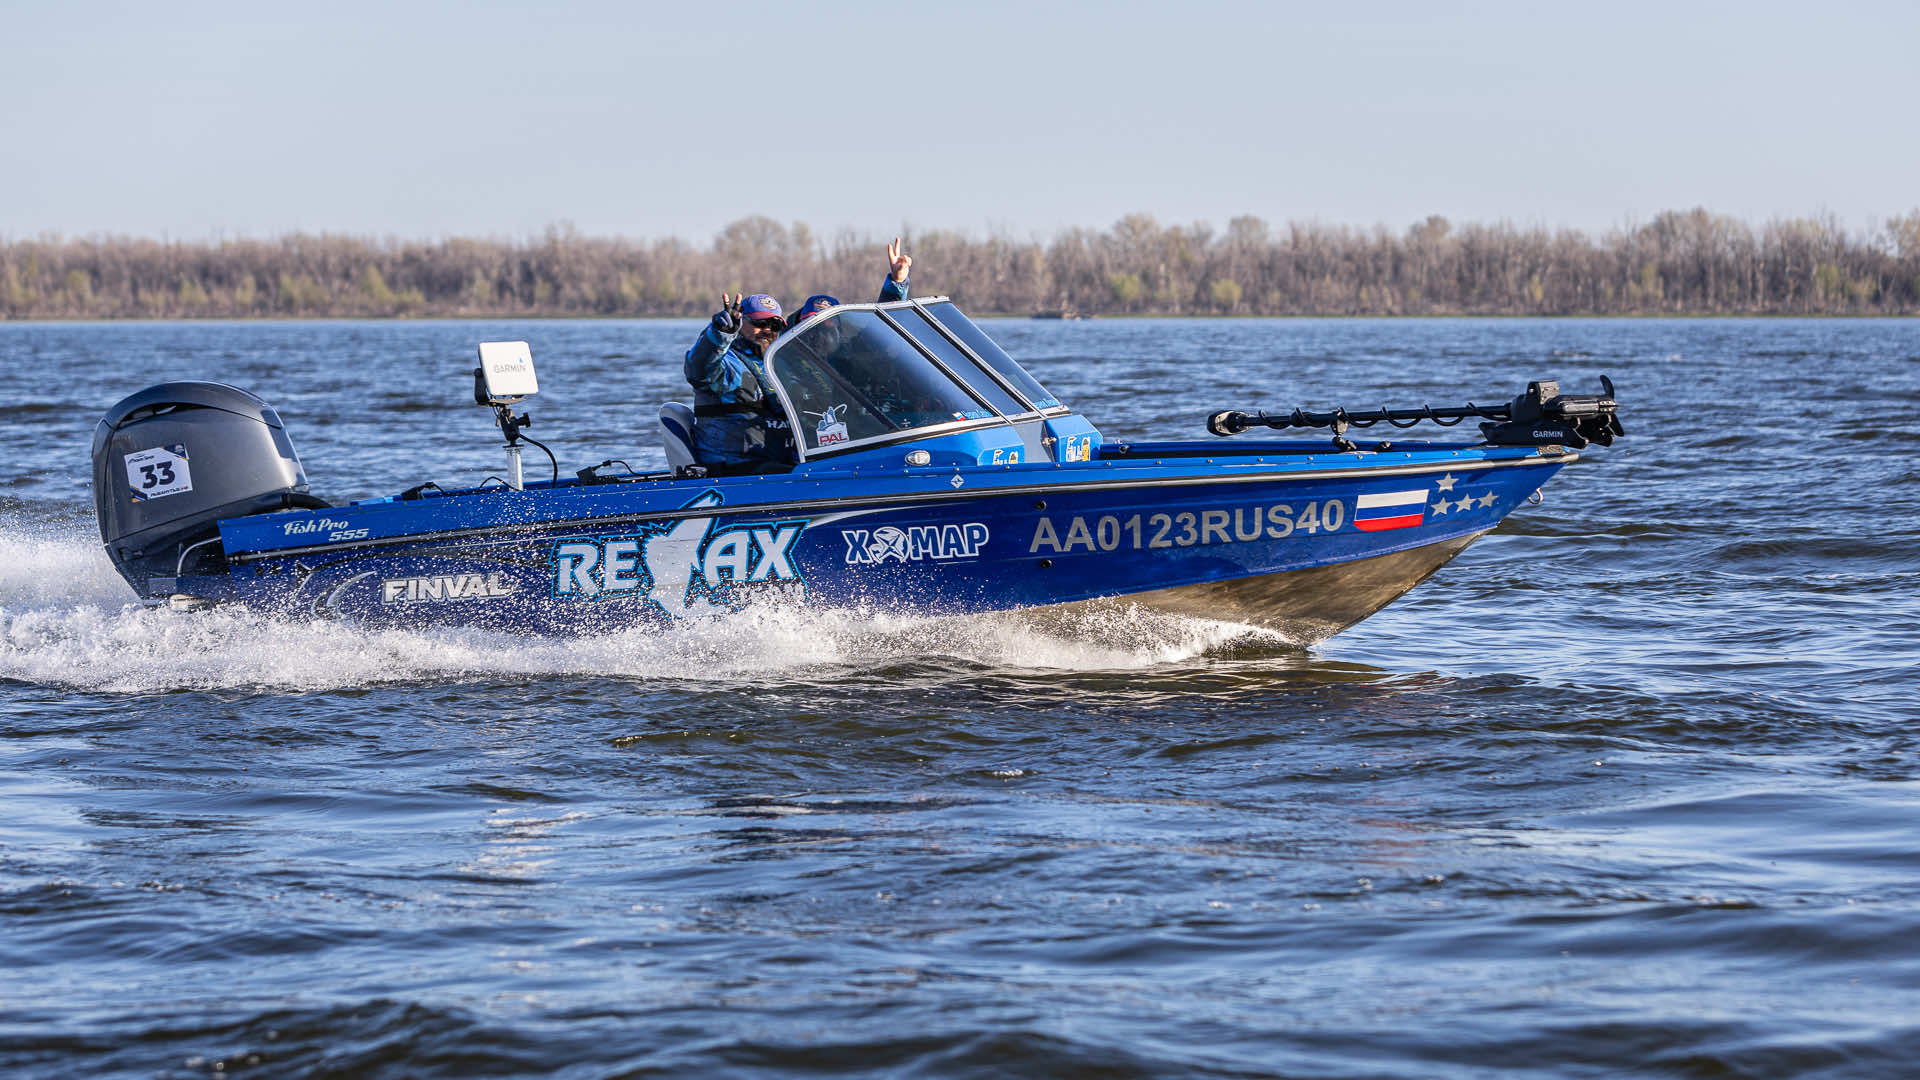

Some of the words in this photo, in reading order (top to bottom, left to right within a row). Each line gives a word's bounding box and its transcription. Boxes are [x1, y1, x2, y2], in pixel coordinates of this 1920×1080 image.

[819, 432, 848, 444] PAL
[1532, 430, 1563, 438] GARMIN
[140, 461, 176, 489] 33
[328, 528, 369, 542] 555
[1029, 499, 1345, 553] AA0123RUS40
[382, 573, 513, 605] FINVAL
